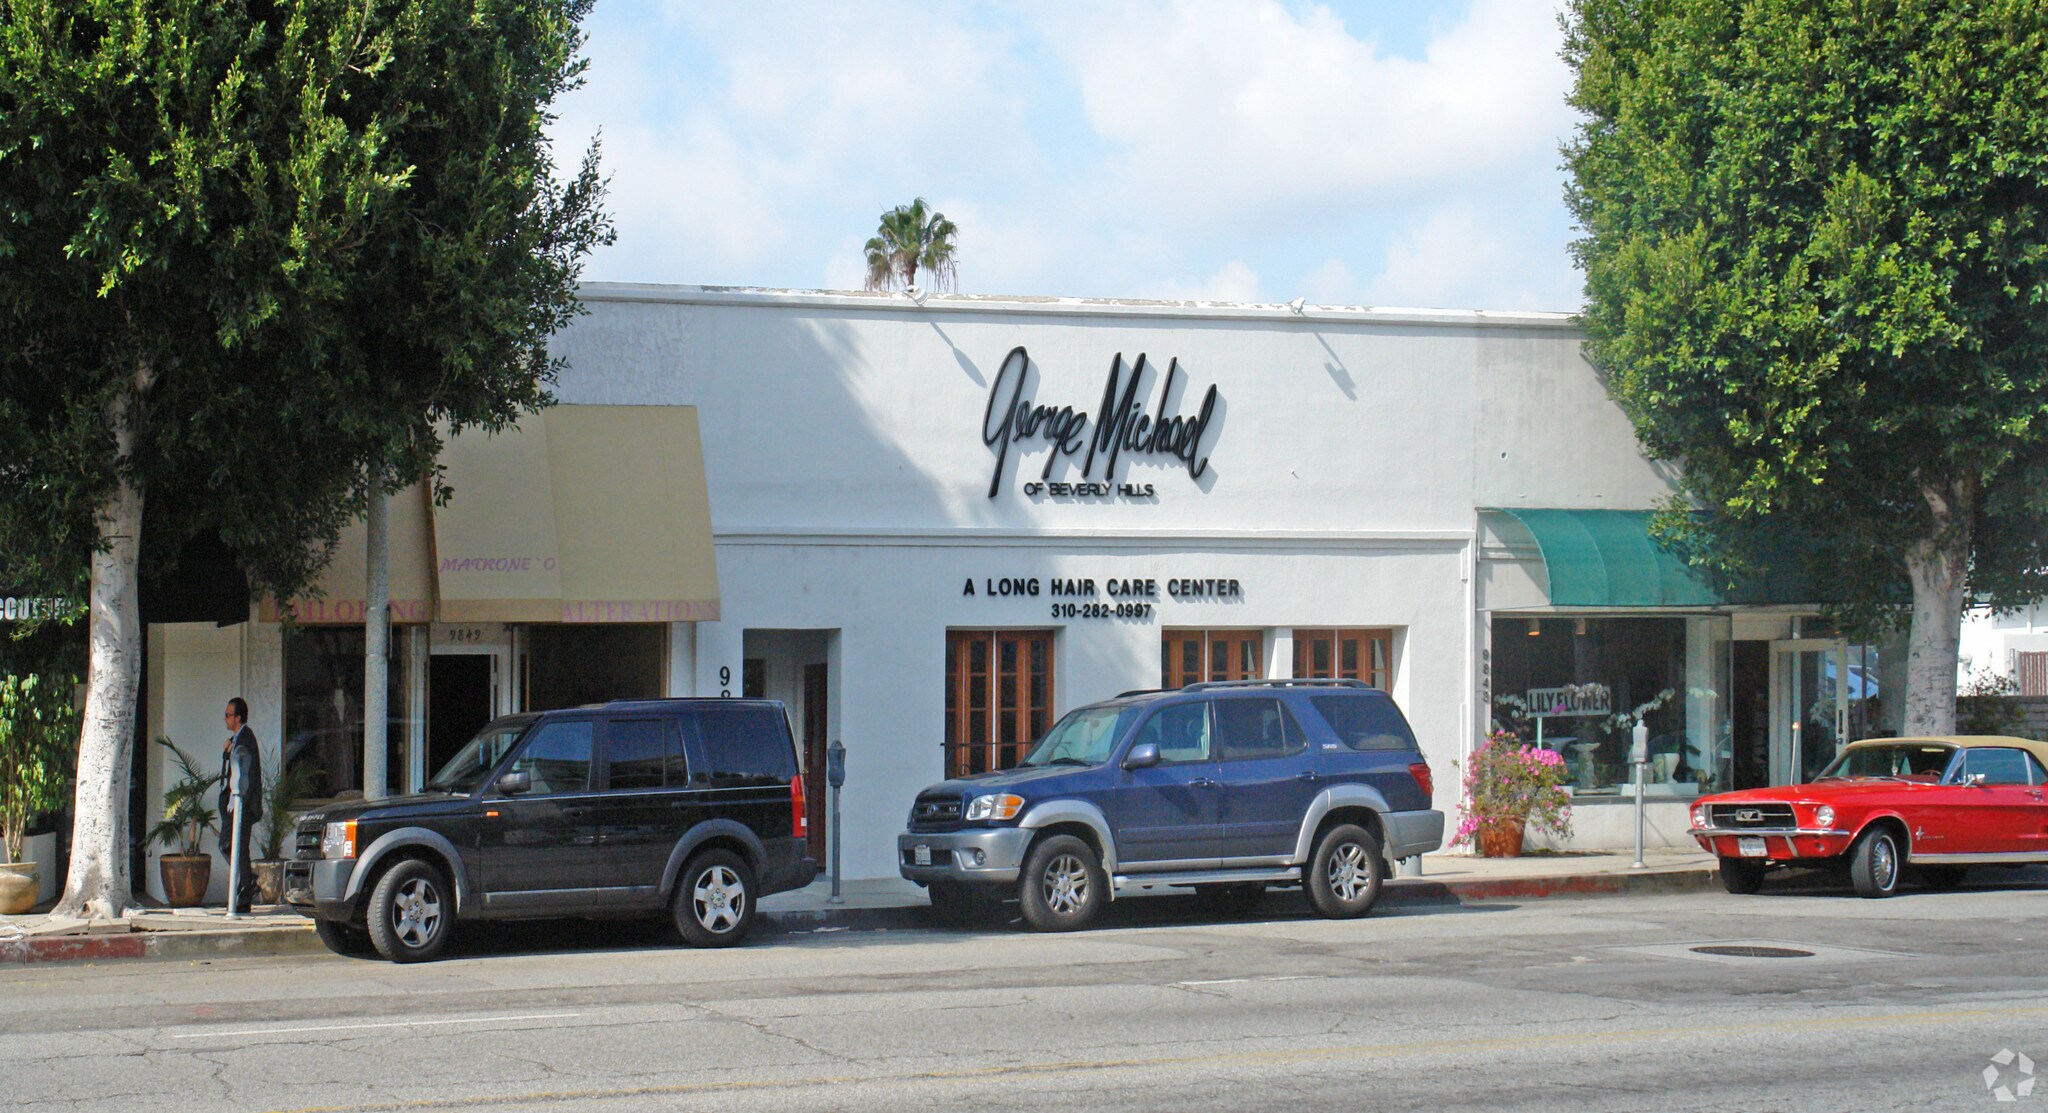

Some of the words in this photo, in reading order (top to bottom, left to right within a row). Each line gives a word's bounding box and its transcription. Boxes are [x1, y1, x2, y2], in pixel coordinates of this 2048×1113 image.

[982, 345, 1087, 499] George
[1081, 351, 1217, 482] Michael
[1023, 482, 1044, 497] OF
[1049, 482, 1112, 497] BEVERLY
[1117, 482, 1155, 497] HILLS
[963, 578, 975, 597] A
[987, 578, 1040, 597] LONG
[1050, 578, 1096, 597] HAIR
[1106, 578, 1156, 597] CARE
[1167, 578, 1241, 597] CENTER
[562, 601, 719, 622] ALTERATIONS
[1051, 603, 1152, 618] 310-282-0997
[450, 629, 482, 642] 9849
